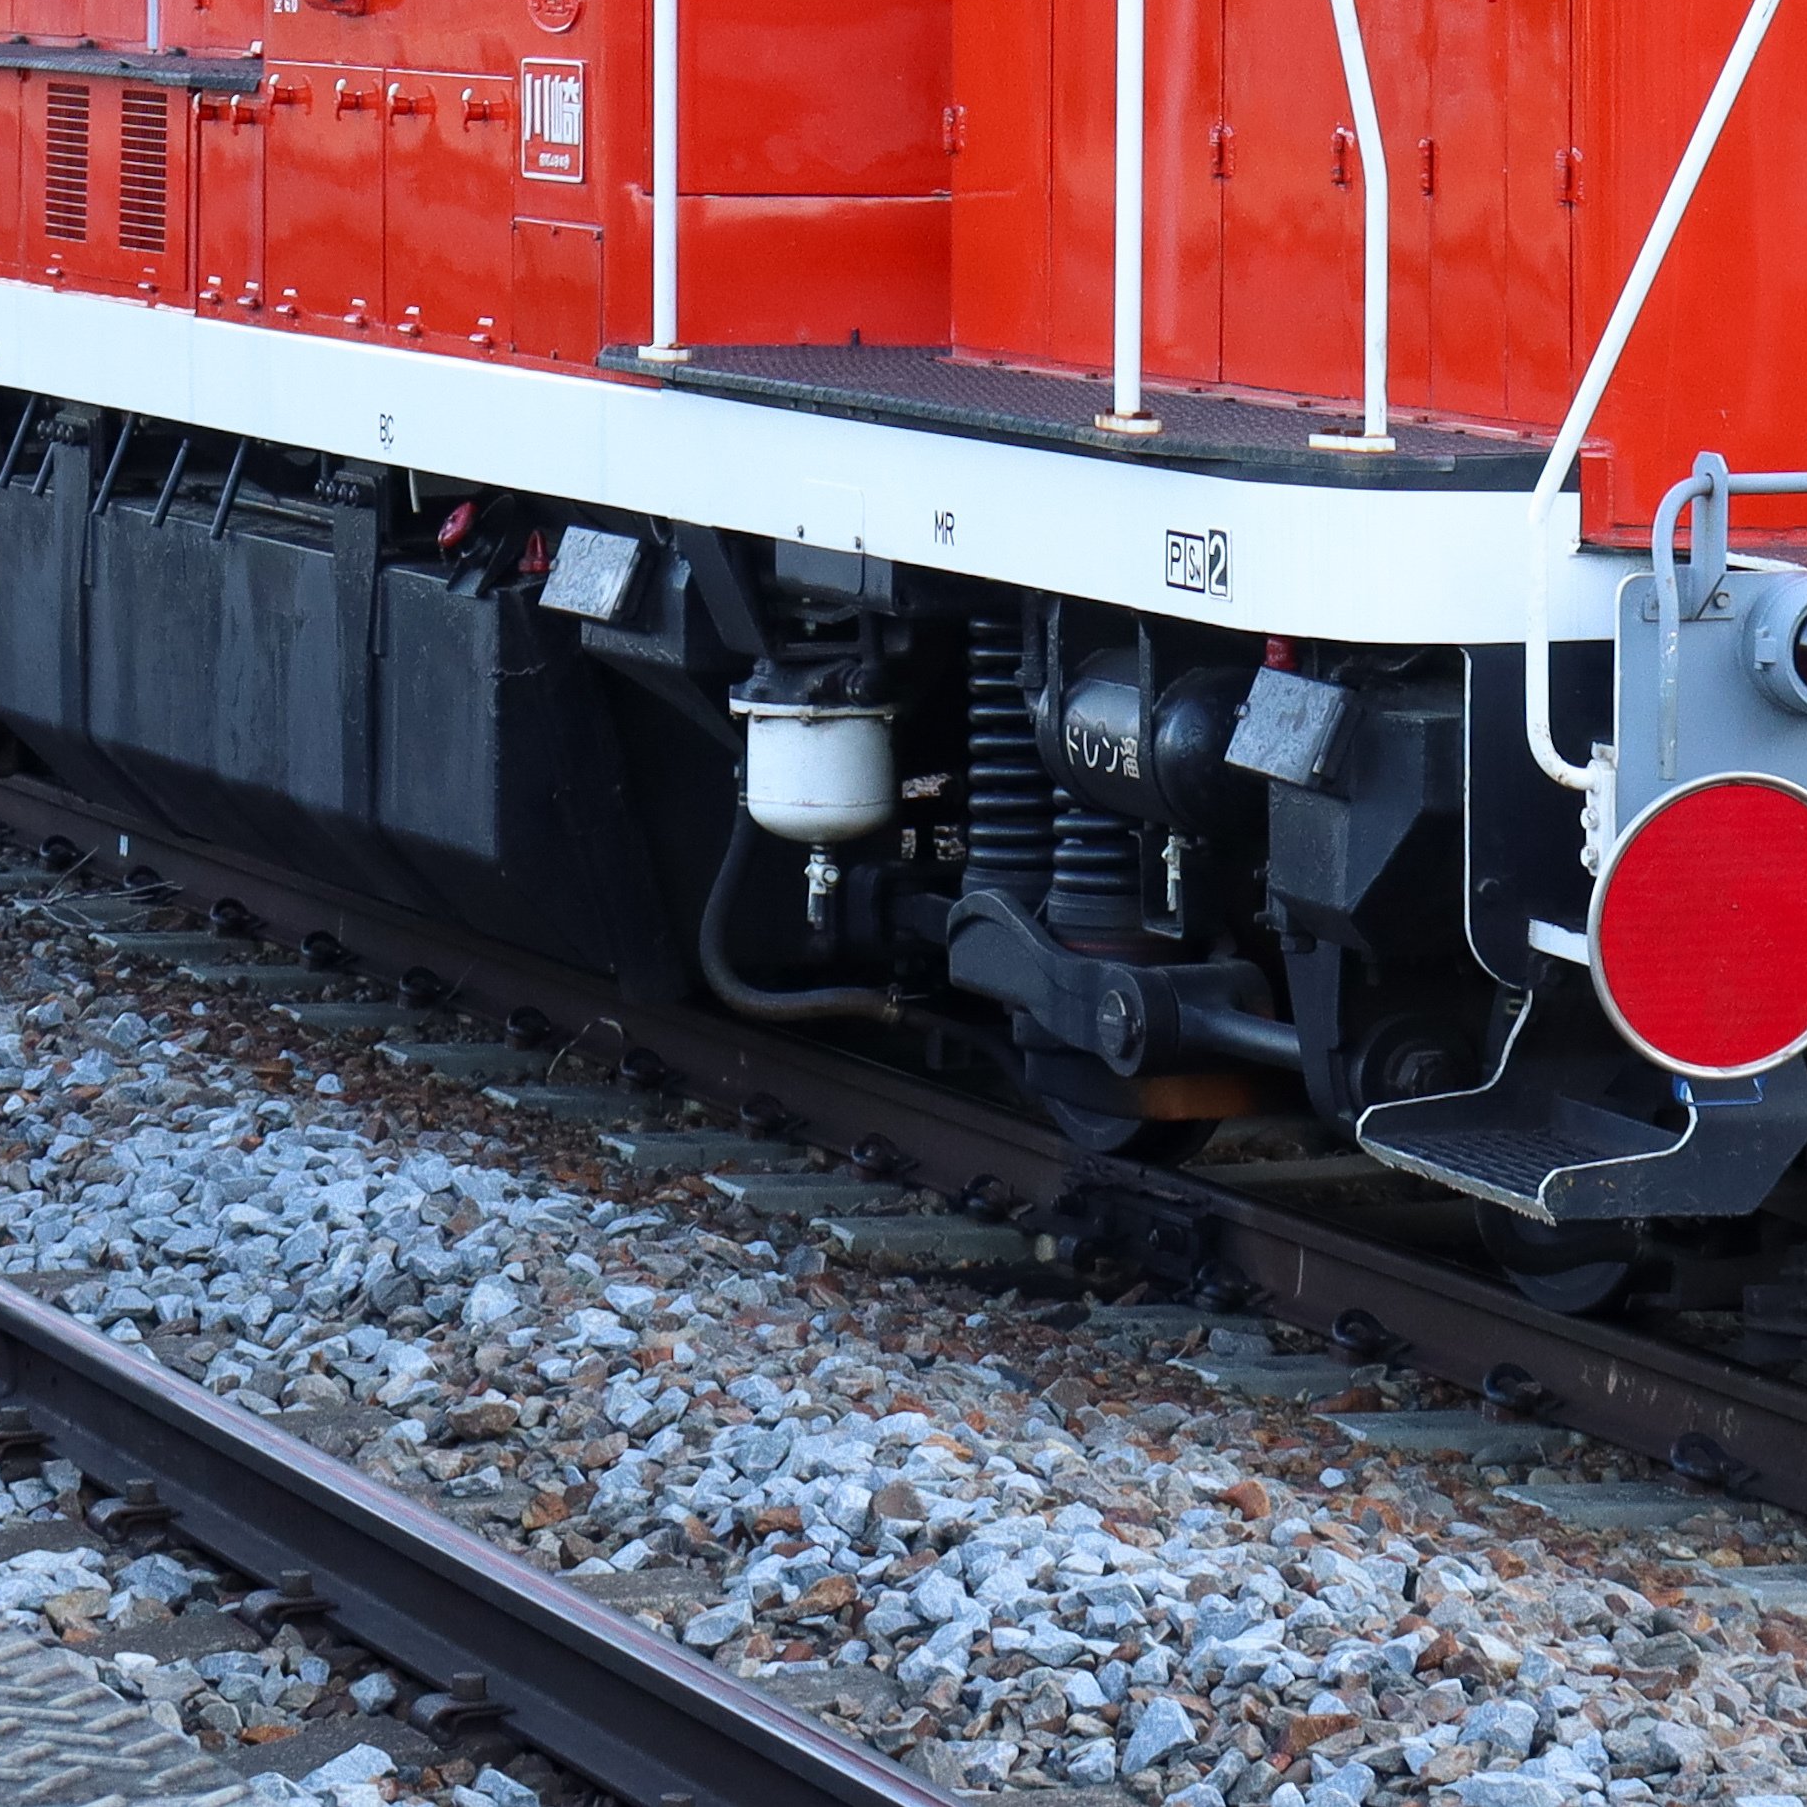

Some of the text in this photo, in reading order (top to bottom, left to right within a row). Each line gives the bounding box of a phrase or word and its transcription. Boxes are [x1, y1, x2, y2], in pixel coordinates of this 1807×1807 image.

[522, 73, 582, 146] 川崎
[379, 413, 395, 444] BC
[934, 509, 955, 547] MR
[1066, 724, 1141, 779] ドレン溜
